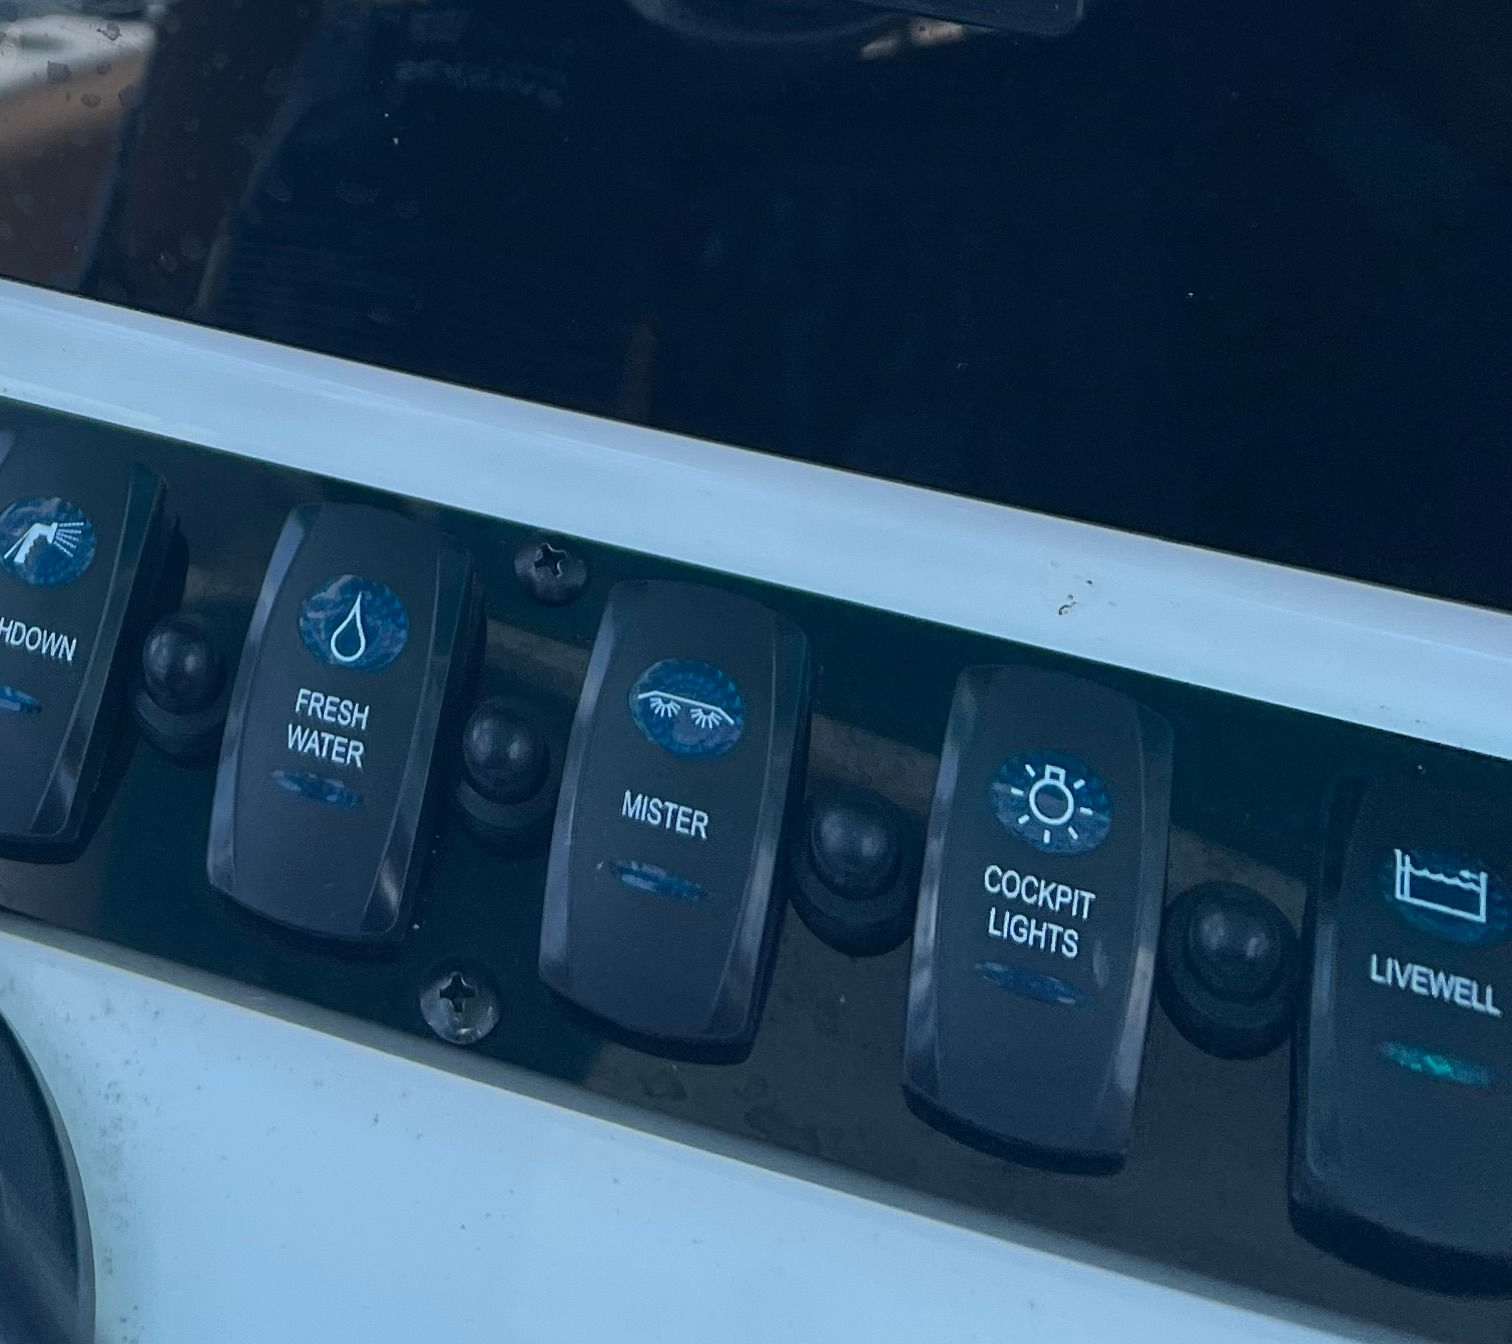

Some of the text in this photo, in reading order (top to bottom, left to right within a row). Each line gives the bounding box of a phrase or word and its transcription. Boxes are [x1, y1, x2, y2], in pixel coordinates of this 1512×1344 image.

[294, 687, 371, 731] FRESH
[287, 723, 365, 769] WATER
[621, 789, 710, 840] MISTER
[983, 863, 1096, 921] COCKPIT
[987, 906, 1080, 960] LIGHTS
[1369, 952, 1502, 1017] LIVEWELL
